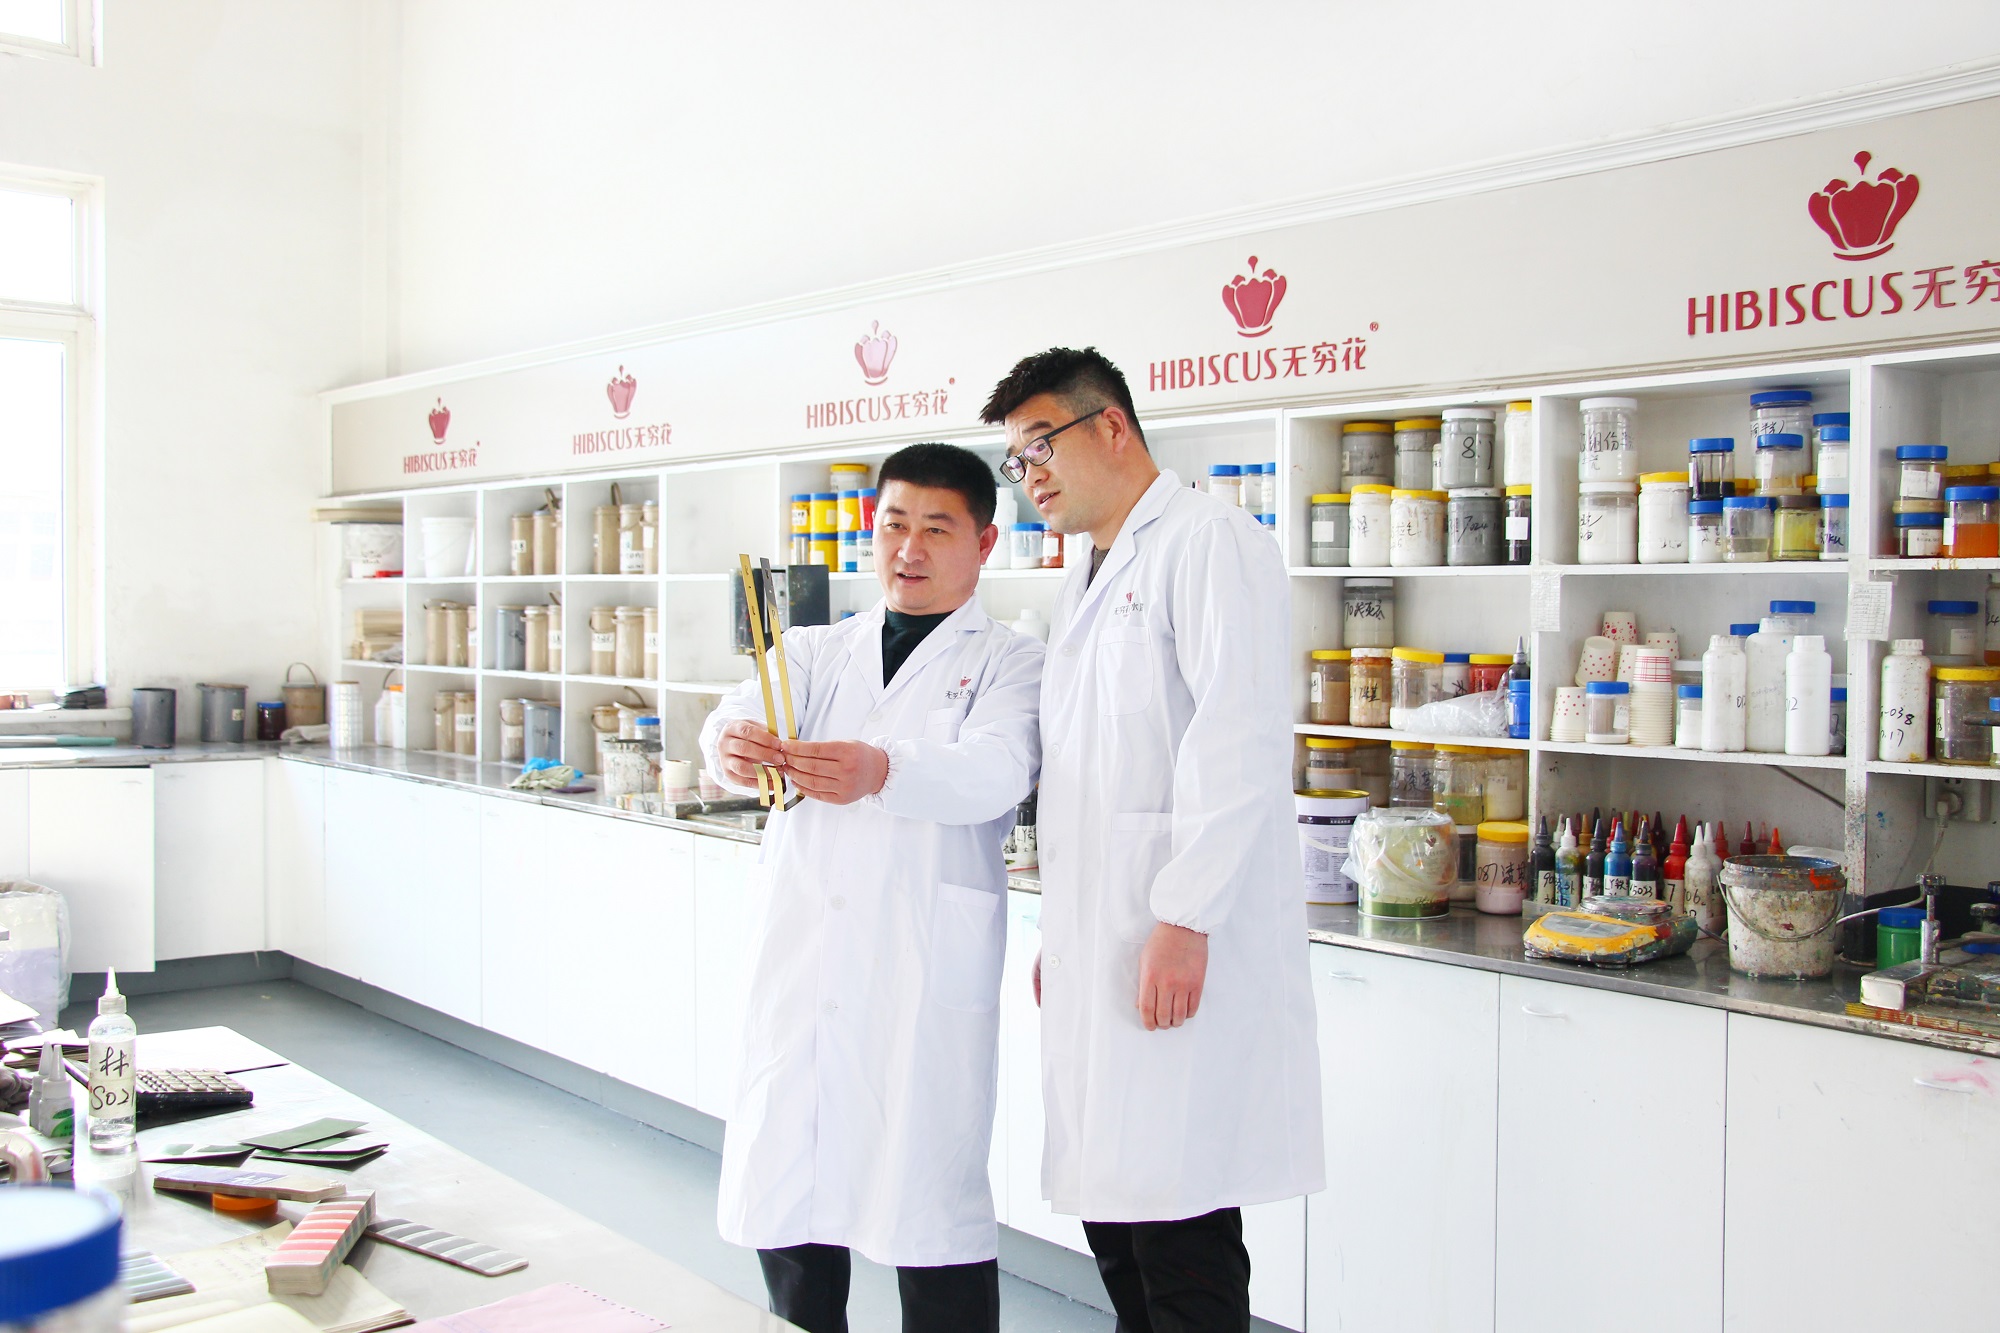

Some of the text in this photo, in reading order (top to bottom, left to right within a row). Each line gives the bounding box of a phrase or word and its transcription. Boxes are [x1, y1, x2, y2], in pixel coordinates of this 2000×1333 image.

[1687, 272, 1904, 337] HIBISCUS
[1149, 336, 1367, 392] HIBISCUS 无穷花
[806, 388, 949, 430] HIBISCUS 无穷花
[572, 427, 633, 455] HIBISCUS
[403, 451, 448, 474] HIBISCUS
